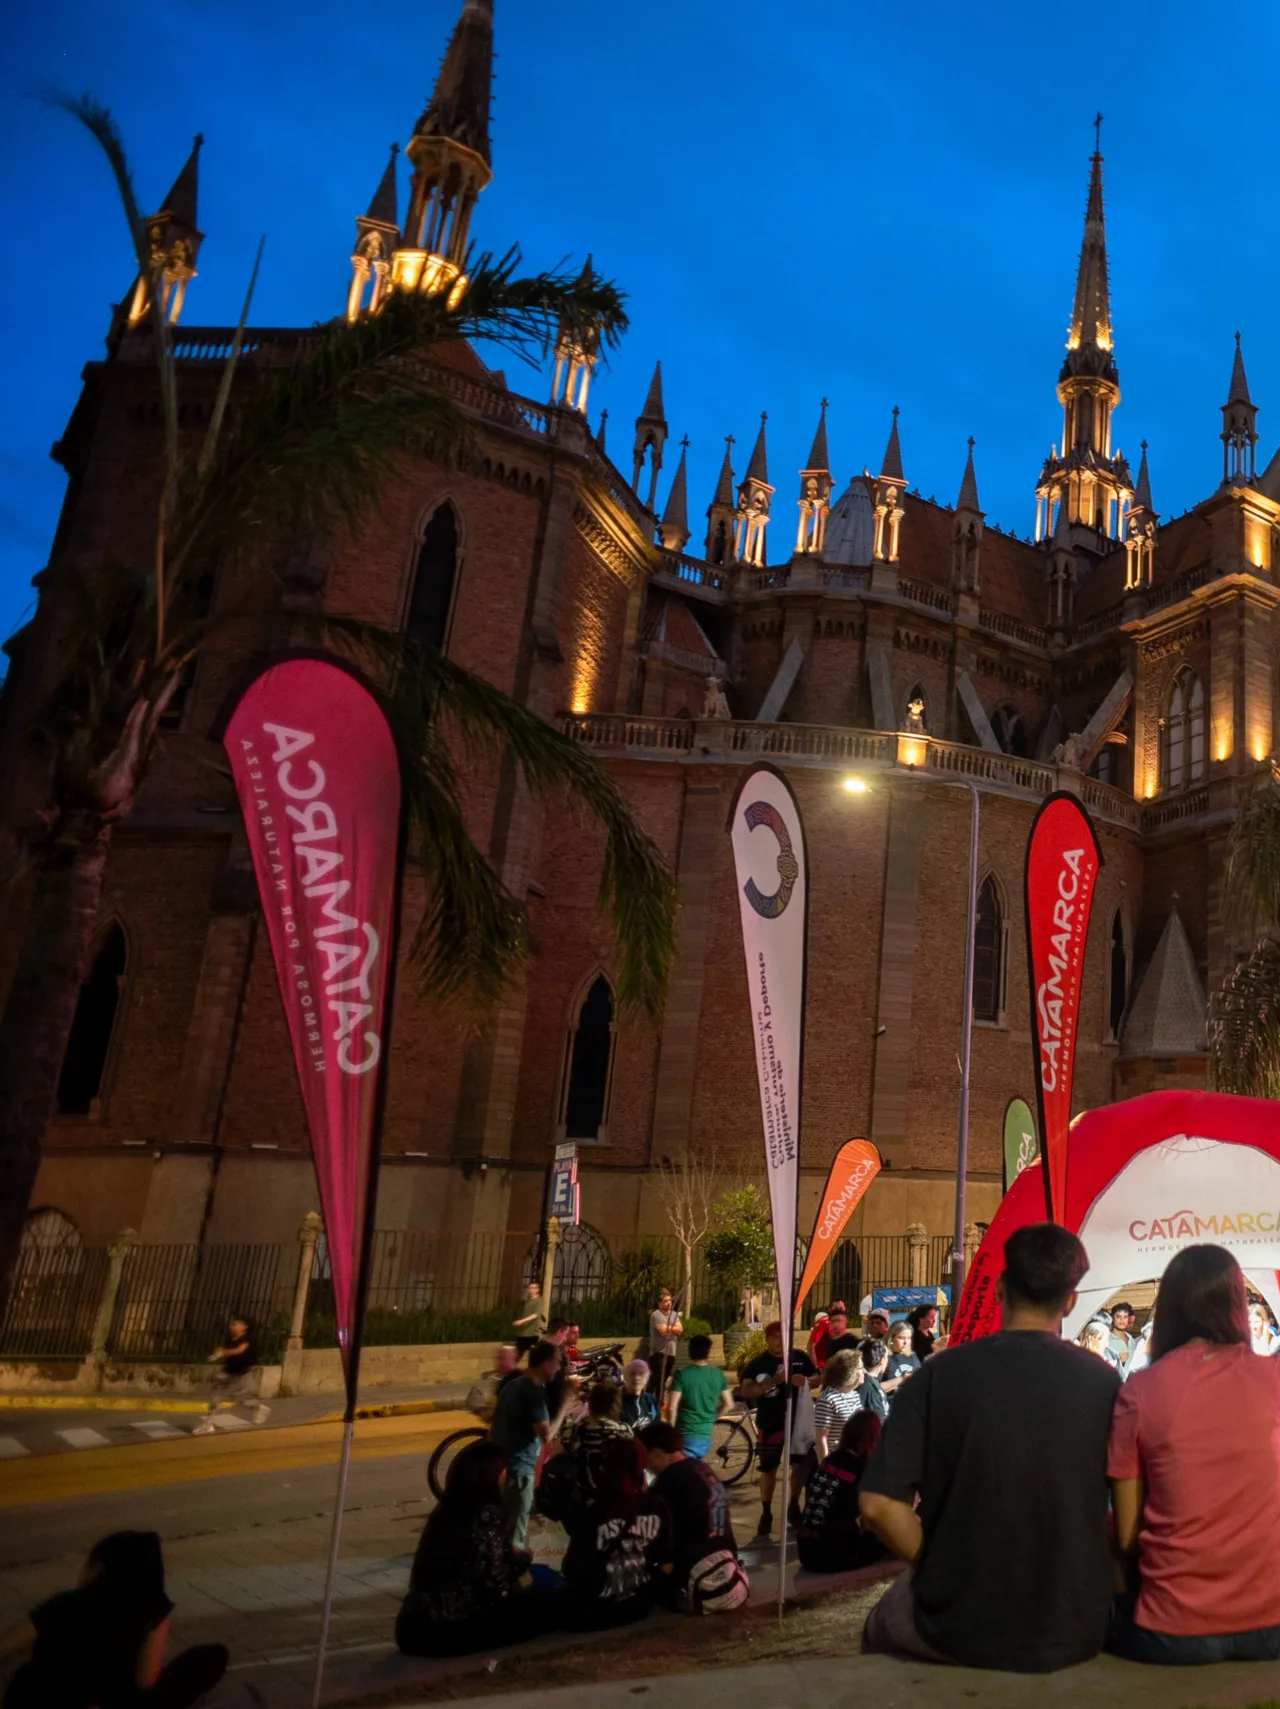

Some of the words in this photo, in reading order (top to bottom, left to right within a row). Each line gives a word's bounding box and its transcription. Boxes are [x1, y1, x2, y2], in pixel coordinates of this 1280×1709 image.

[1038, 848, 1085, 1092] CATAMARCA
[1061, 1016, 1073, 1093] HERMOSA
[1068, 976, 1076, 1006] POR
[1072, 863, 1093, 967] NATURALEZA
[554, 1172, 569, 1203] E
[818, 1159, 875, 1240] CATAMARCA
